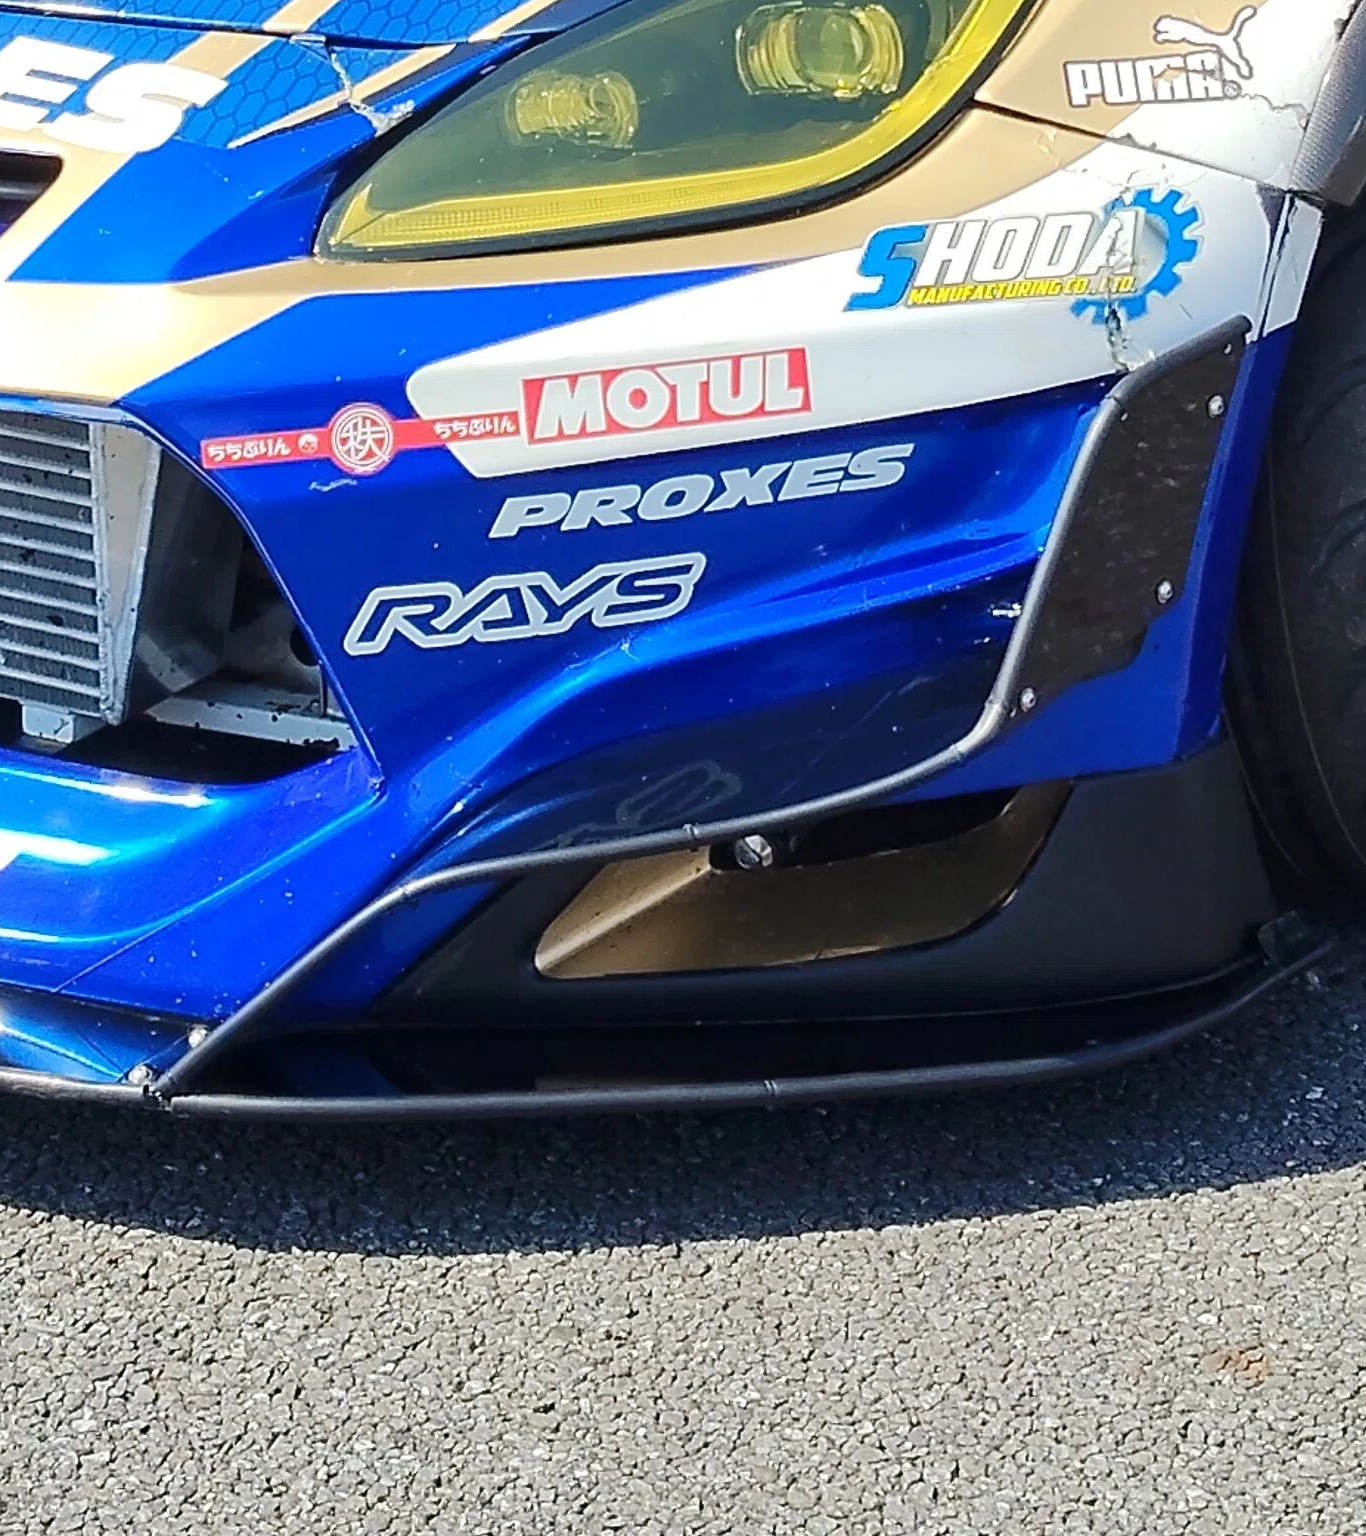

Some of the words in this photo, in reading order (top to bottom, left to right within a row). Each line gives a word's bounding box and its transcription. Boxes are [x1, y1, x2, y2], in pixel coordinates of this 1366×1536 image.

[842, 208, 1146, 312] SHODA
[907, 278, 1063, 306] MANUFACTURING
[207, 437, 292, 462] ちちぶりん
[434, 414, 517, 439] ちちぶりん
[531, 350, 805, 442] MOTUL
[487, 441, 917, 540] PROXES
[342, 551, 707, 656] RAYS
